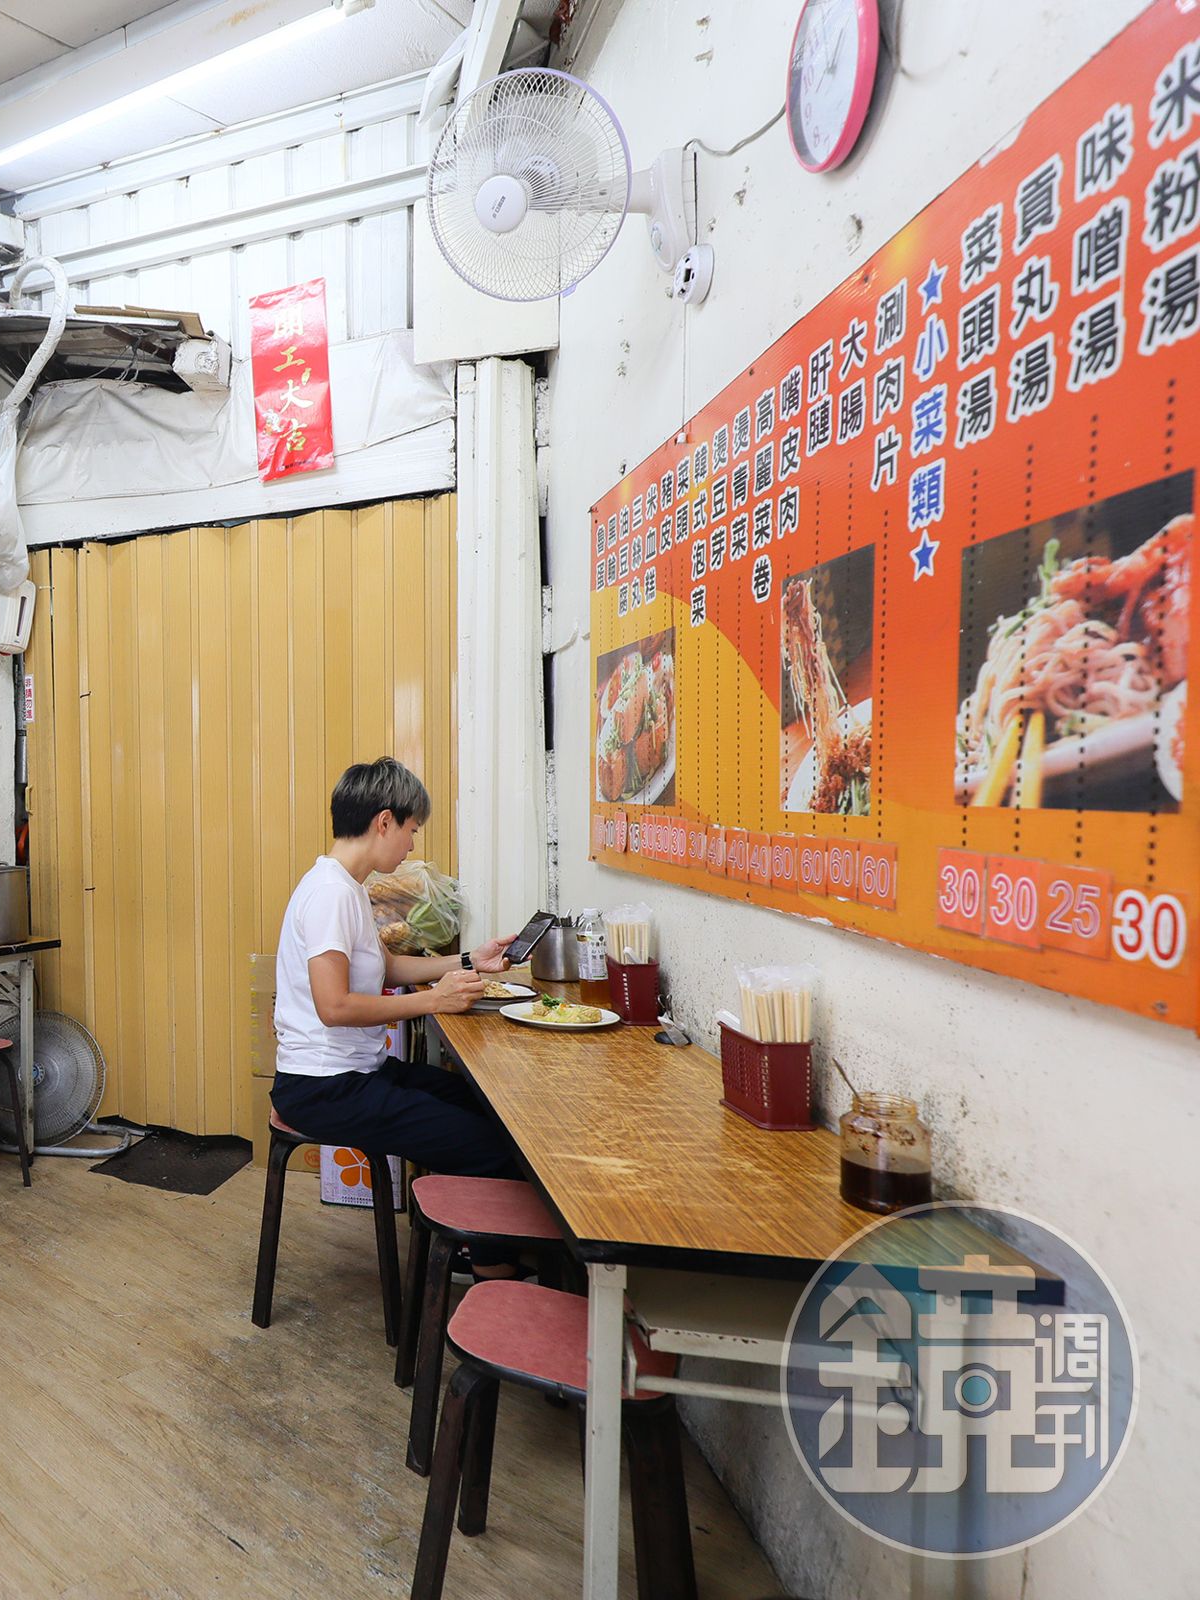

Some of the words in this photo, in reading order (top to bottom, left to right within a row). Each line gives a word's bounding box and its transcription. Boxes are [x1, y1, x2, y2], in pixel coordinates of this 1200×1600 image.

[1137, 37, 1200, 356] 米粉湯
[1006, 153, 1063, 423] 貢丸湯
[1066, 103, 1134, 392] 味噌湯
[954, 203, 1003, 449] 菜頭湯
[272, 303, 314, 452] 開工大吉
[836, 317, 868, 445] 大腸
[870, 277, 908, 492] 涮肉片
[777, 365, 803, 539] 嘴皮肉
[908, 313, 949, 532] 小菜類
[659, 470, 674, 555] 豬皮
[675, 456, 690, 545] 菜頭
[710, 423, 728, 571] 燙豆芽
[730, 405, 750, 562] 燙青菜
[751, 386, 775, 603] 高麗菜卷
[644, 483, 657, 604] 米血糕
[690, 441, 709, 628] 韓式泡菜
[642, 822, 653, 850] 30
[656, 824, 669, 853] 30
[671, 827, 687, 857] 30
[689, 830, 704, 859] 30
[708, 836, 723, 867] 40
[728, 840, 745, 871] 40
[750, 844, 769, 878] 40
[772, 844, 793, 880] 60
[802, 848, 823, 886] 60
[830, 847, 852, 887] 60
[862, 855, 890, 898] 60
[939, 864, 980, 918] 30
[990, 873, 1038, 931] 30
[1045, 880, 1101, 938] 25
[1112, 889, 1187, 969] 30
